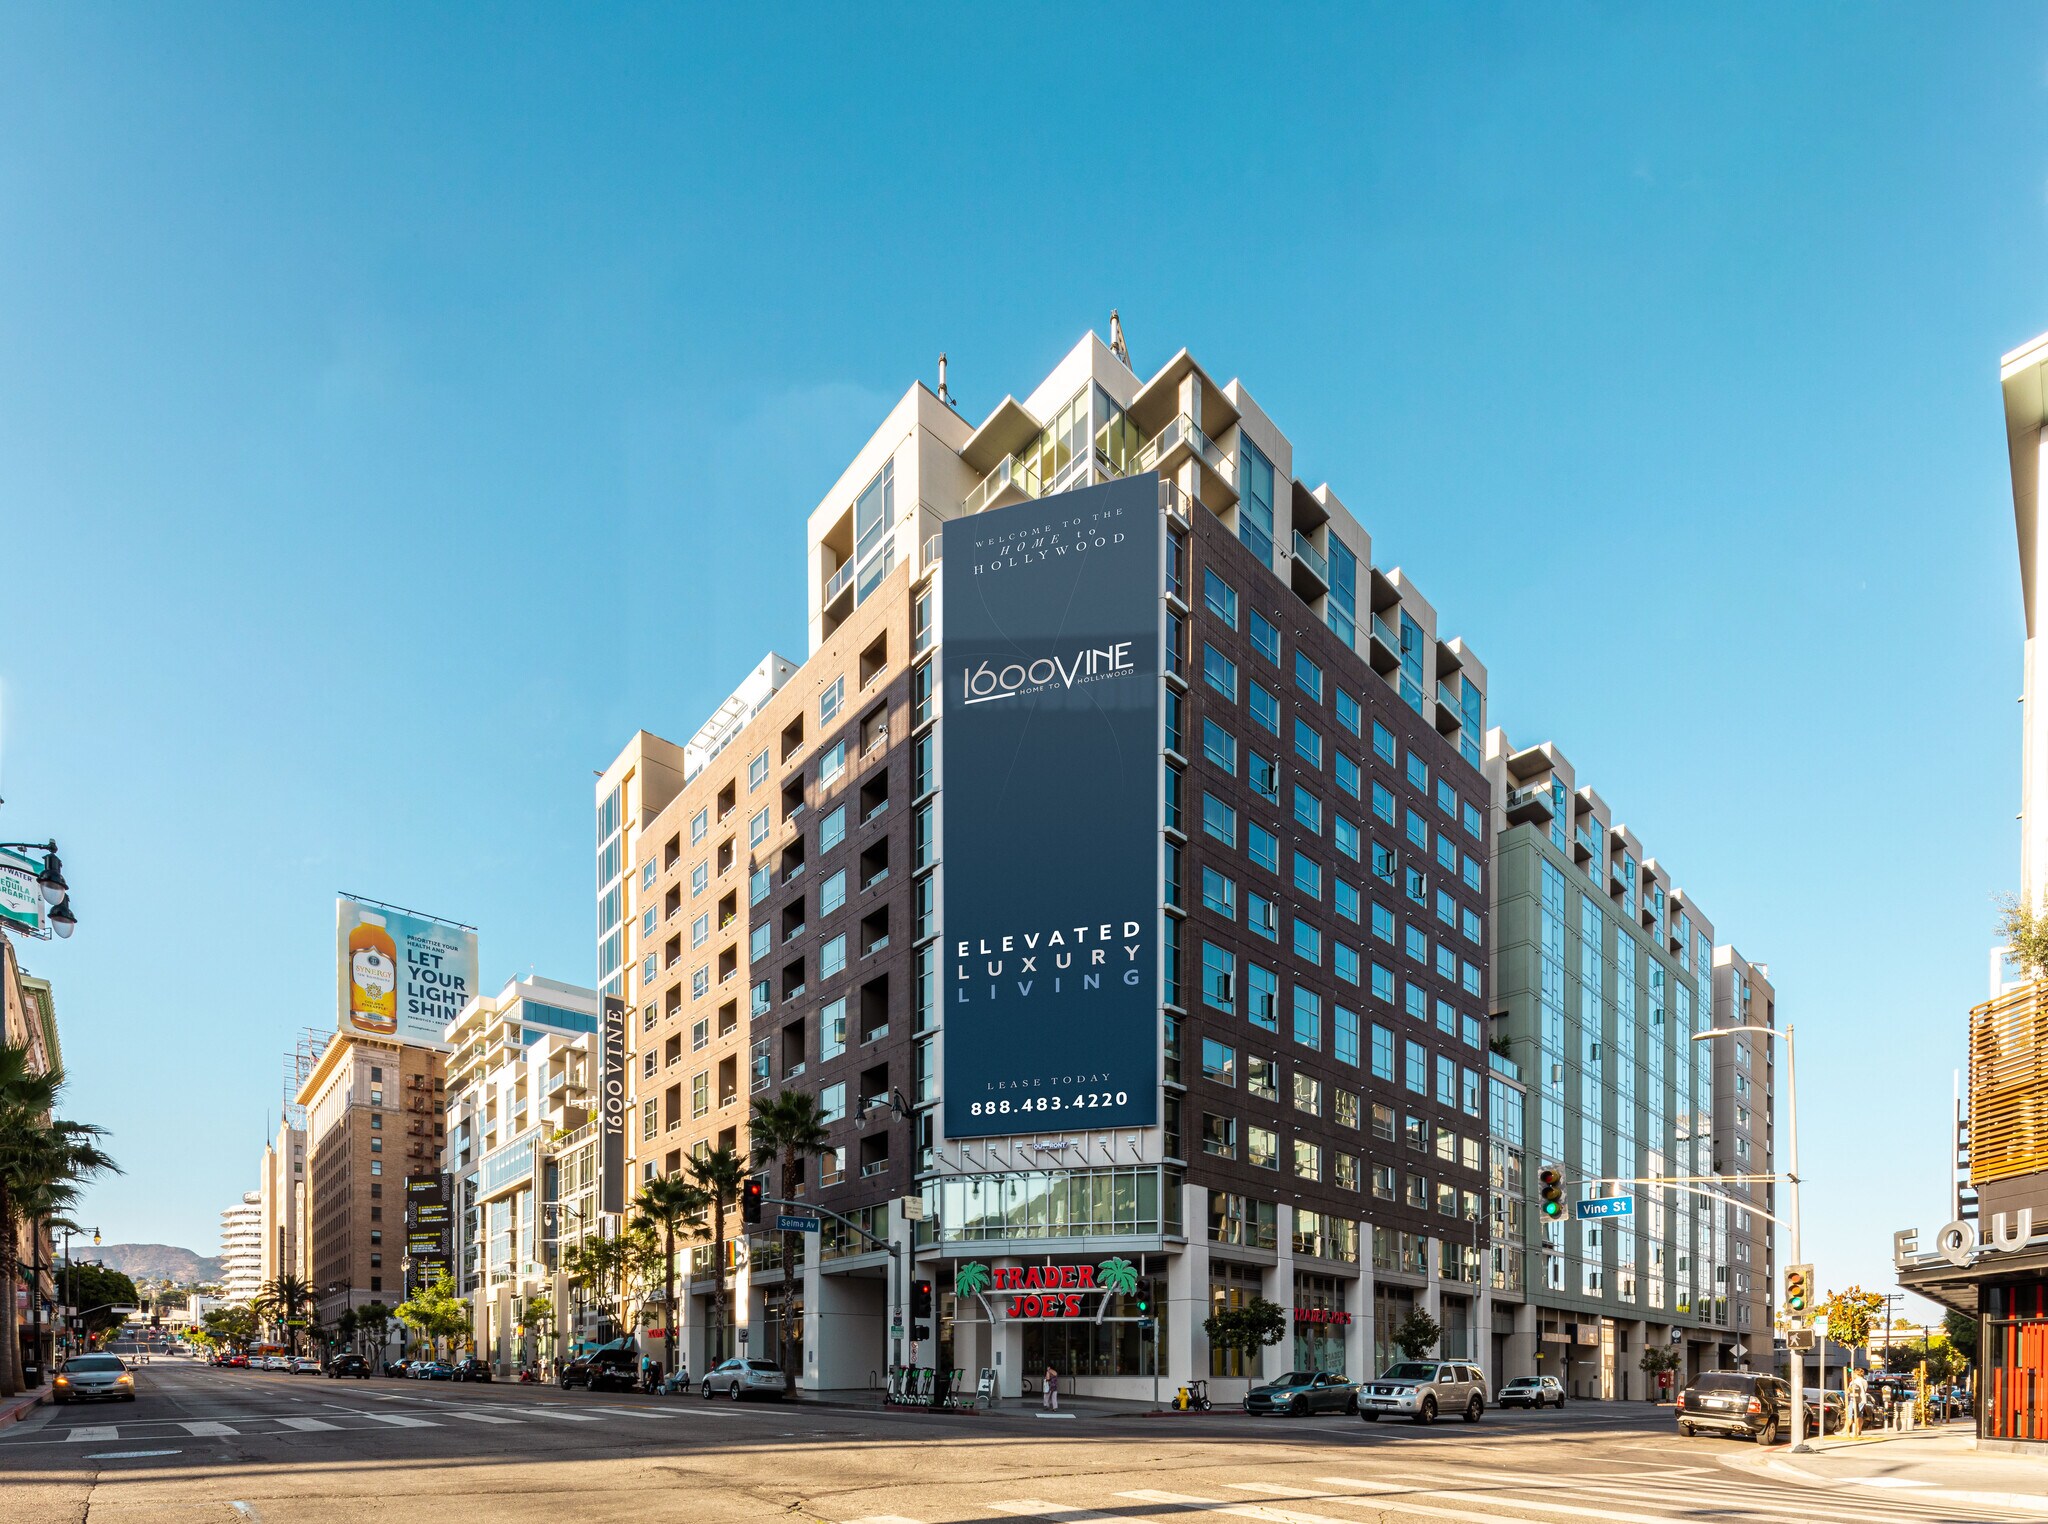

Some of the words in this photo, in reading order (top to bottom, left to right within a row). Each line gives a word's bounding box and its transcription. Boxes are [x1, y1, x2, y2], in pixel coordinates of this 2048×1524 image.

[975, 524, 1051, 548] WELCOME
[1062, 517, 1081, 528] TO
[1092, 508, 1123, 521] THE
[973, 532, 1125, 576] HOLLYWOOD
[1000, 533, 1060, 556] HOME
[1076, 528, 1096, 539] to
[1019, 685, 1044, 695] HOME
[1049, 682, 1060, 690] TO
[1077, 668, 1134, 684] HOLLYWOOD
[407, 935, 441, 947] PRIORITIZE
[442, 942, 459, 952] YOUR
[407, 941, 431, 951] HEALTH
[958, 921, 1140, 957] ELEVATED
[407, 949, 443, 969] LET
[958, 944, 1141, 980] LUXURY
[355, 965, 392, 979] SYNERGY
[408, 965, 466, 991] YOUR
[408, 982, 469, 1007] LIGHT
[958, 969, 1140, 1003] LIVING
[408, 999, 462, 1021] SHIN
[606, 1010, 623, 1075] VINE
[987, 1078, 1041, 1090] LEASE
[1050, 1073, 1111, 1085] TODAY
[606, 1080, 623, 1134] 1600
[971, 1091, 1128, 1116] 888.483.4220
[1583, 1204, 1608, 1215] Vine
[1613, 1201, 1626, 1212] St
[781, 1218, 804, 1228] Selma
[806, 1221, 816, 1229] Av
[1894, 1207, 2032, 1268] EQU
[993, 1265, 1097, 1290] TRADER
[1007, 1293, 1085, 1318] JOE'S
[1294, 1307, 1327, 1323] TRADER
[1329, 1312, 1352, 1325] JOE'S
